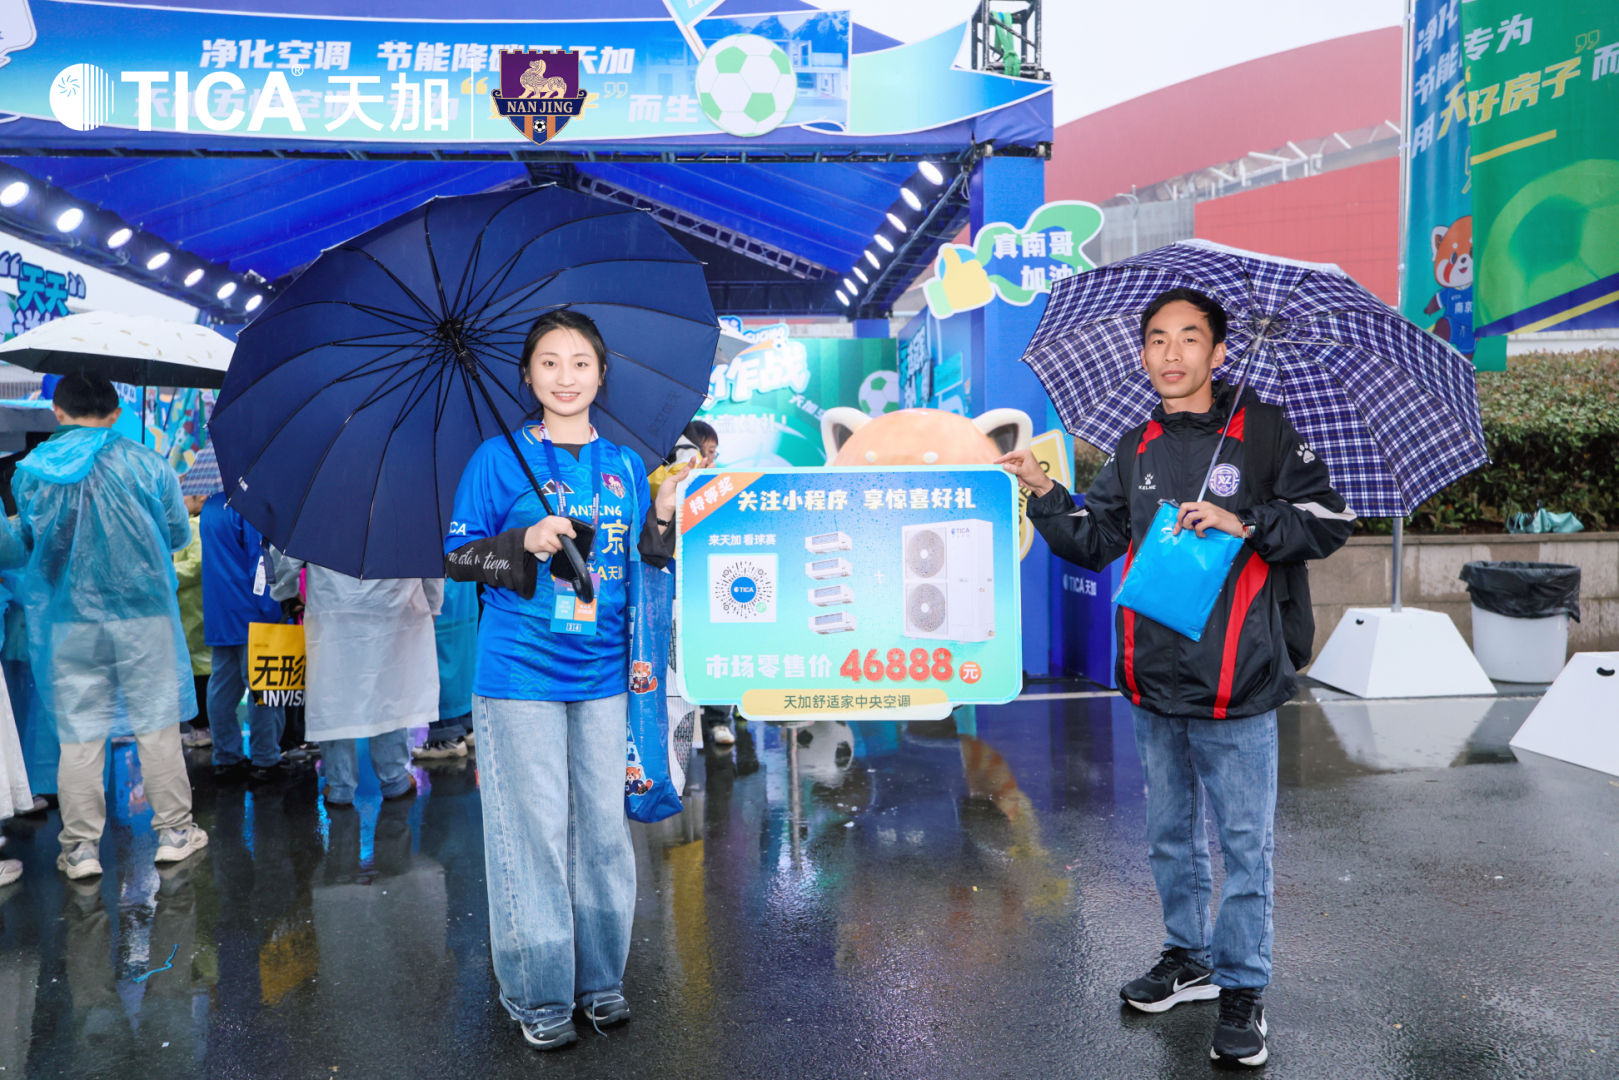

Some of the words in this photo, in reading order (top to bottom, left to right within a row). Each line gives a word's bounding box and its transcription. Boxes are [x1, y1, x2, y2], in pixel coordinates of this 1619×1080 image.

[1464, 13, 1534, 61] 专为
[200, 39, 352, 71] 净化空调
[993, 231, 1074, 260] 真南哥
[737, 489, 848, 512] 关注小程序
[863, 487, 977, 511] 享惊喜好礼
[705, 653, 832, 680] 市场零售价
[839, 647, 955, 683] 46888
[962, 664, 979, 680] 元
[783, 694, 911, 710] 天加舒适家中央空调
